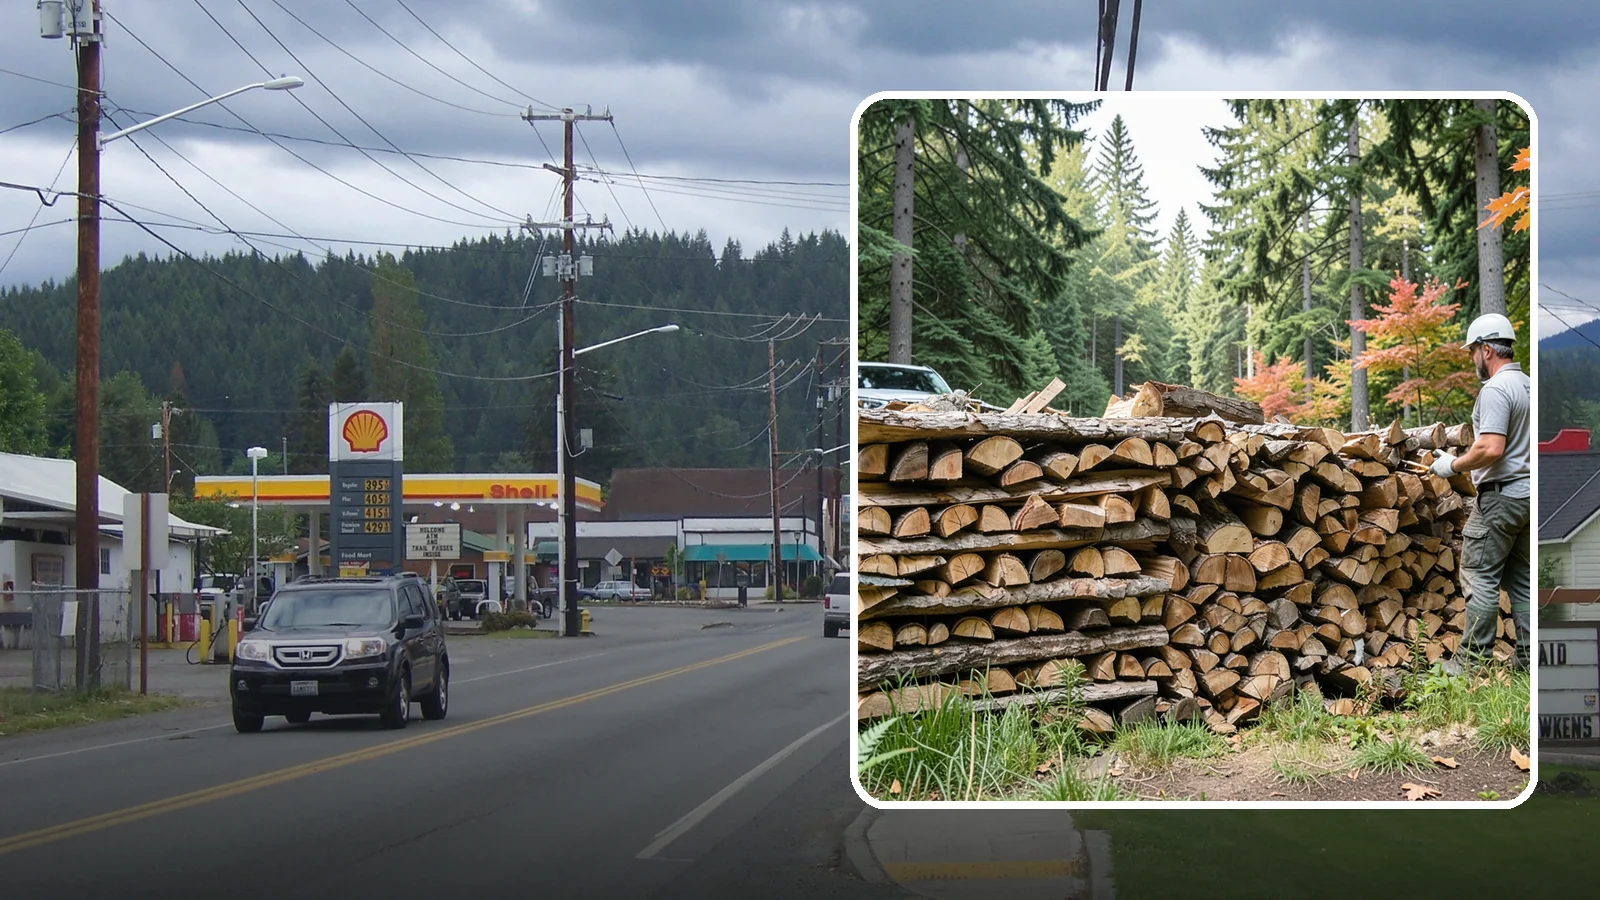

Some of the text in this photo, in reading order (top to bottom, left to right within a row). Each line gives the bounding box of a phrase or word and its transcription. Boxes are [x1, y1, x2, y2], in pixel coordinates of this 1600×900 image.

[366, 480, 383, 490] 395
[490, 484, 547, 499] Shell
[366, 494, 383, 504] 405
[366, 508, 383, 518] 415
[366, 522, 383, 532] 429
